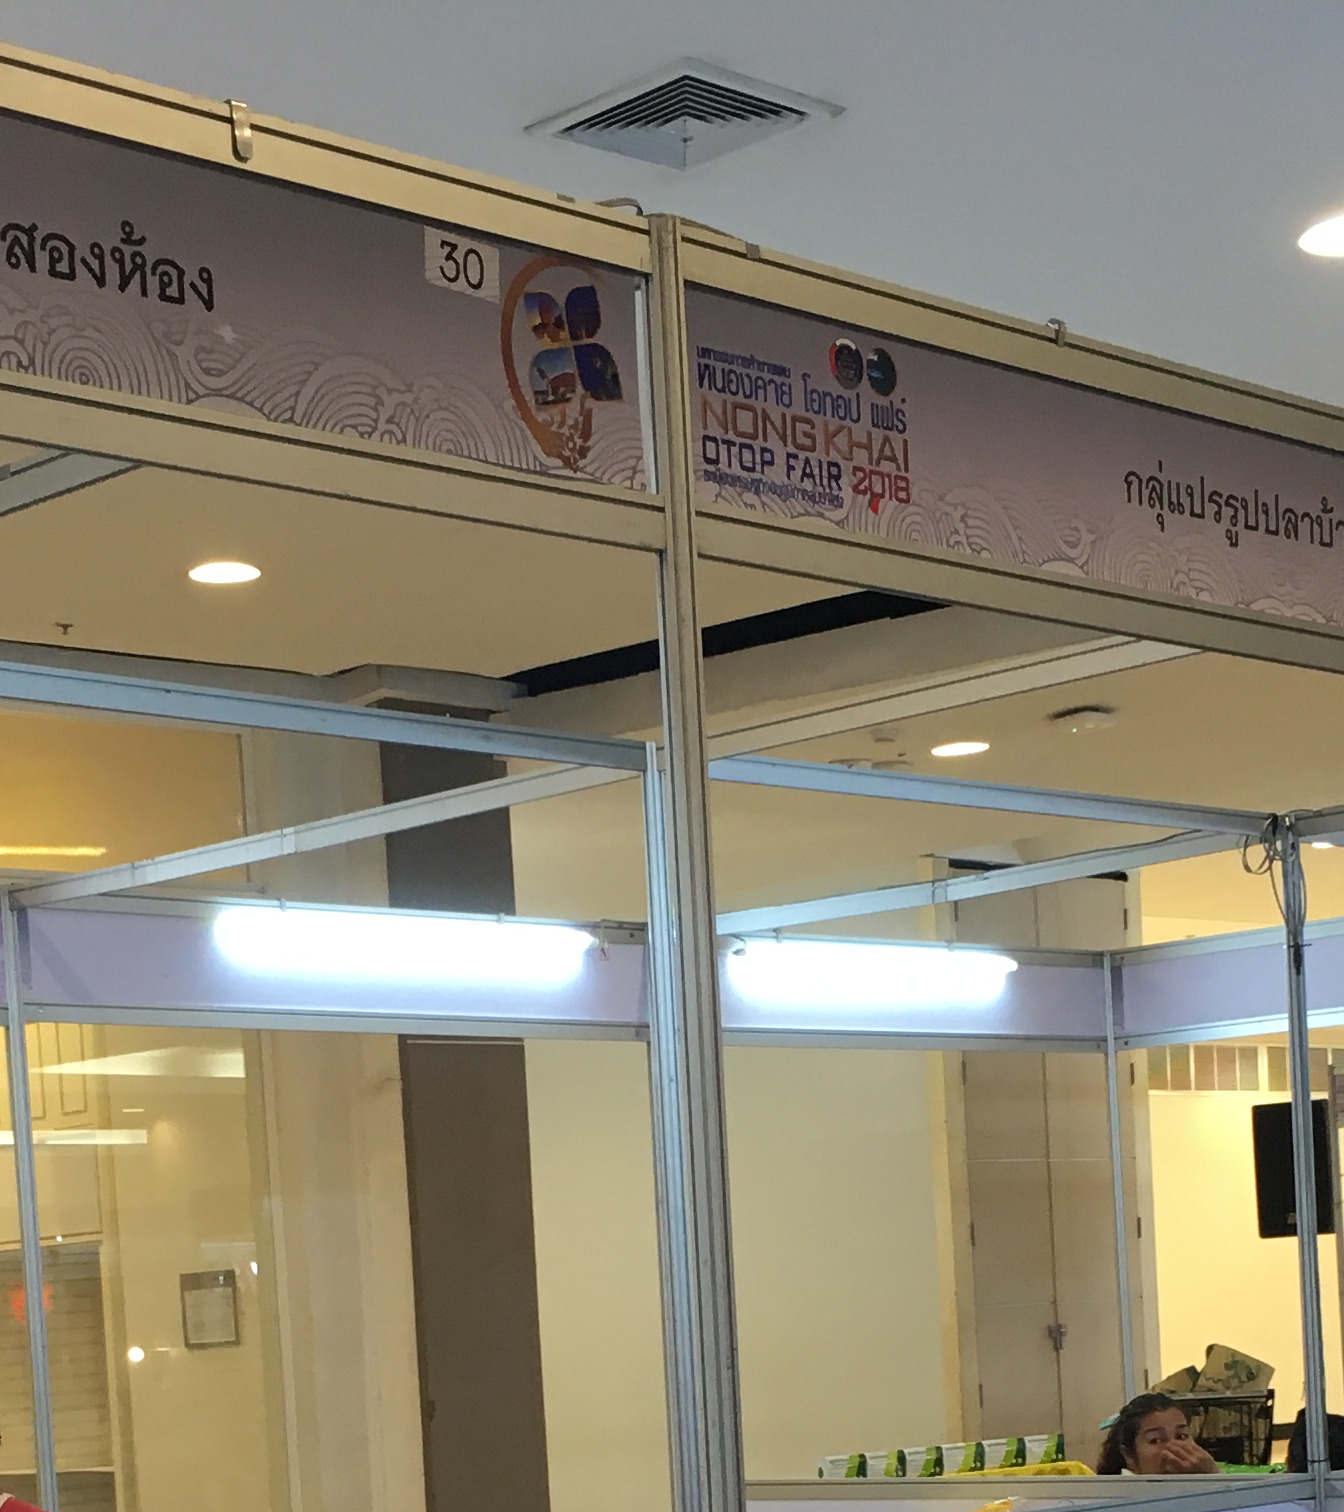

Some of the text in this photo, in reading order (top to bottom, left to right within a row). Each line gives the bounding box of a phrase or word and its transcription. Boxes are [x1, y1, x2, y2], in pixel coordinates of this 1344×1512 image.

[439, 238, 485, 291] 30
[697, 362, 907, 435] หนองคาย โอทอป แฟร์
[700, 394, 909, 474] NONG KHAI
[702, 434, 774, 476] OTOP
[786, 450, 842, 492] FAIR
[852, 465, 910, 504] 2018
